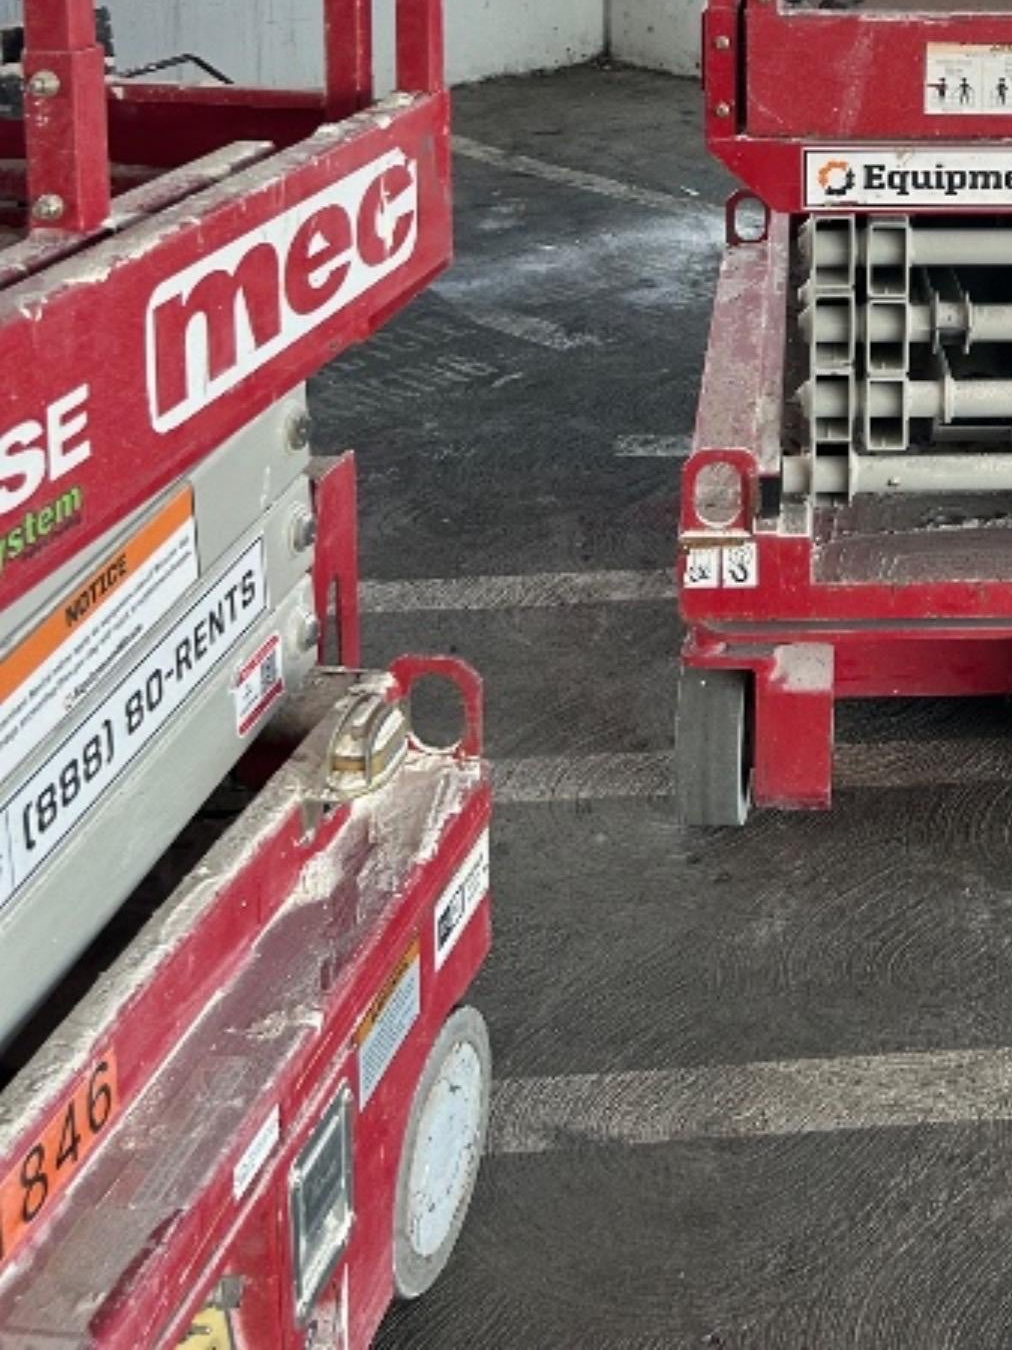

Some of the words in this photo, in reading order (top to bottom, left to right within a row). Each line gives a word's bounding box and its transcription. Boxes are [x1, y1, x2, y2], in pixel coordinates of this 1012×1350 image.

[63, 552, 128, 627] NOTICE
[22, 718, 115, 851] (888)
[124, 568, 256, 735] 80-RENTS
[0, 1059, 113, 1260] 846
